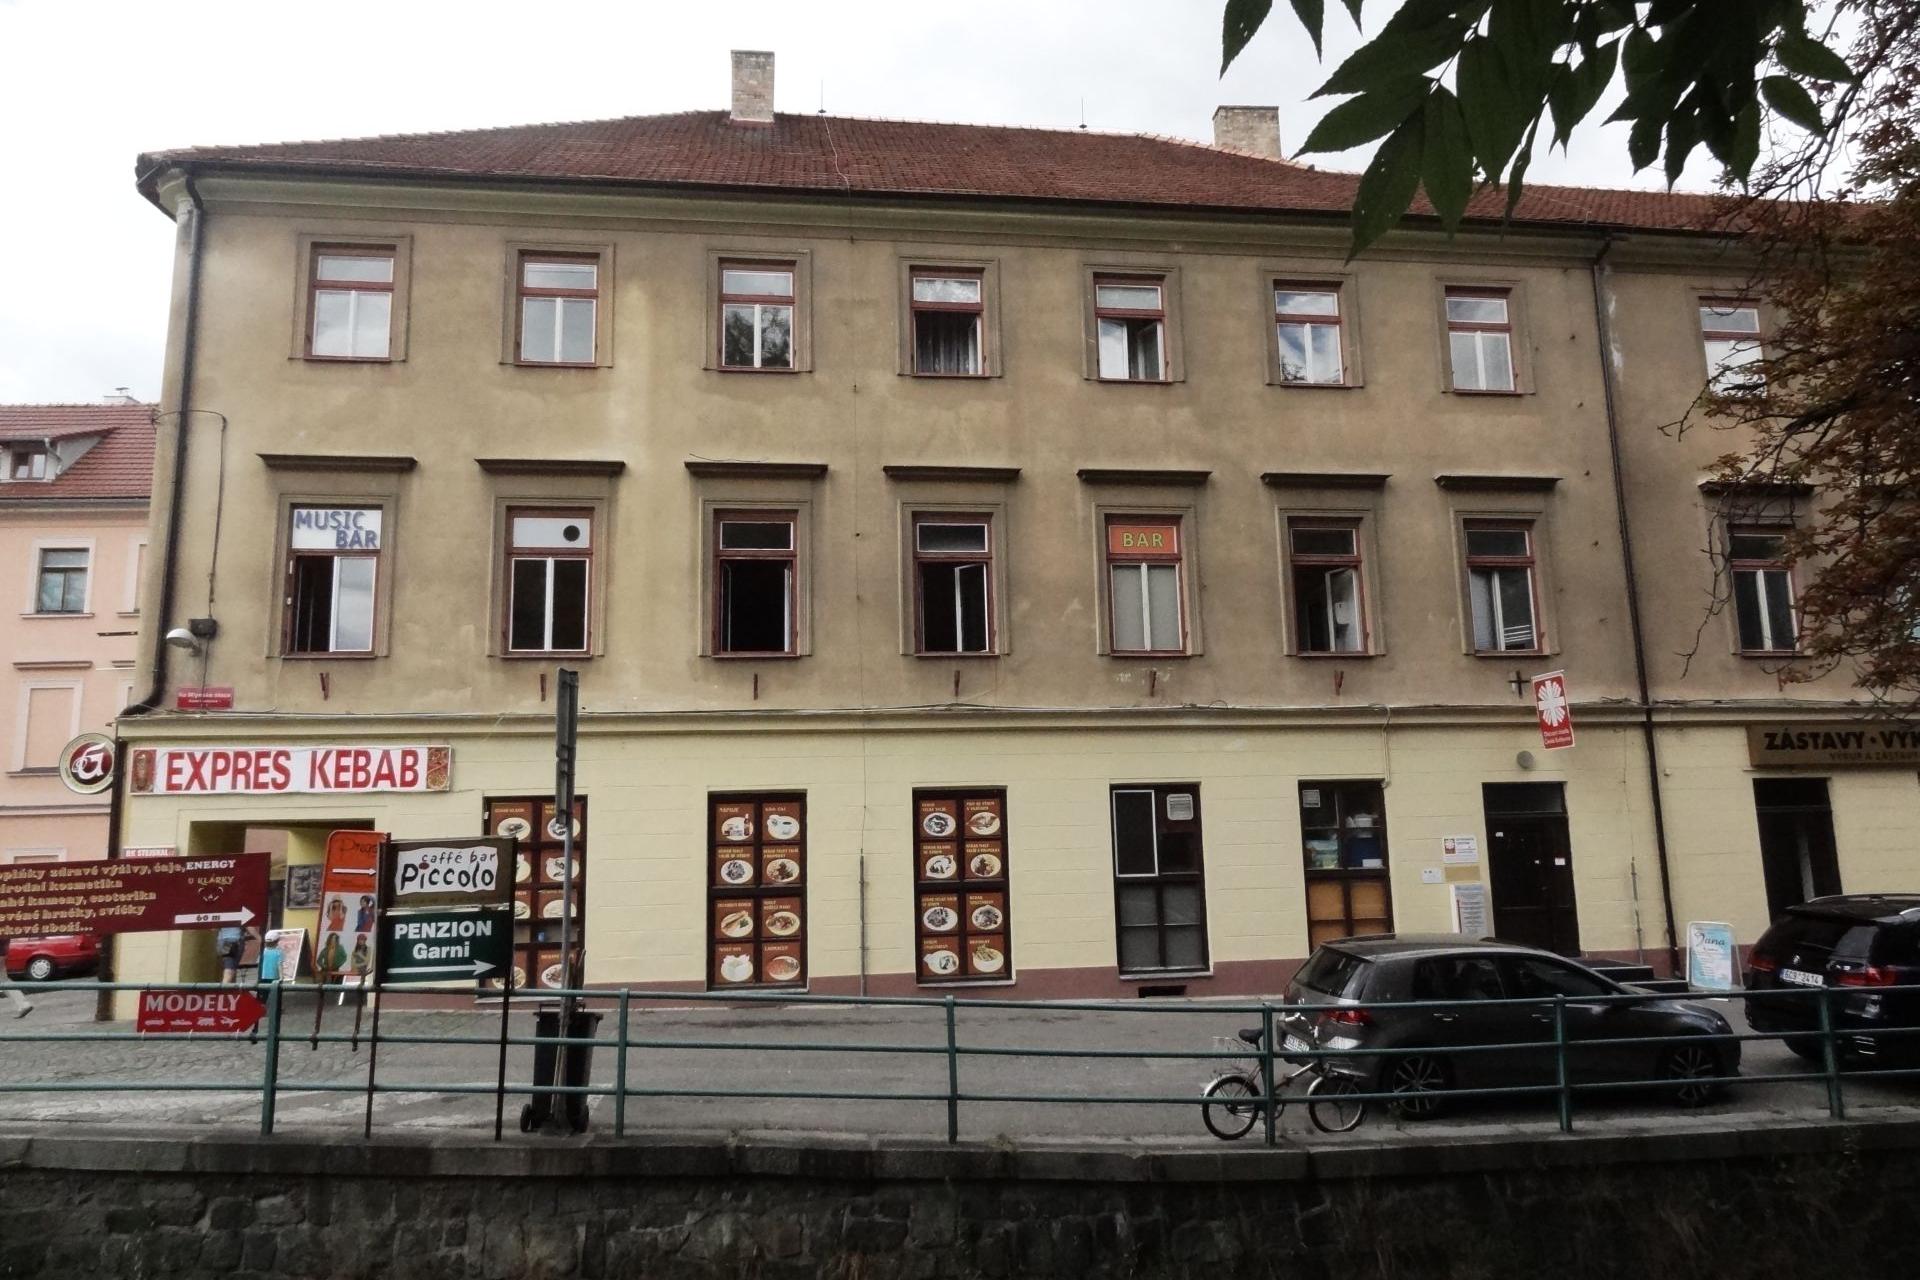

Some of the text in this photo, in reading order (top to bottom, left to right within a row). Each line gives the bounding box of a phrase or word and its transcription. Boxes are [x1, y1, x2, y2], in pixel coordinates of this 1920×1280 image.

[295, 510, 366, 530] MUSIC
[335, 530, 378, 548] BAR
[1123, 532, 1163, 547] BAR
[1763, 728, 1865, 750] ZÁSTAVY
[165, 748, 419, 791] EXPRES KEBAB
[186, 859, 236, 870] ENERGY
[421, 850, 497, 864] caffé bar
[49, 879, 123, 891] kosmetika
[400, 861, 495, 891] Piccolo
[196, 914, 209, 922] 60
[394, 920, 492, 939] PENZION
[412, 941, 470, 959] Garni
[145, 994, 241, 1012] MODELY
